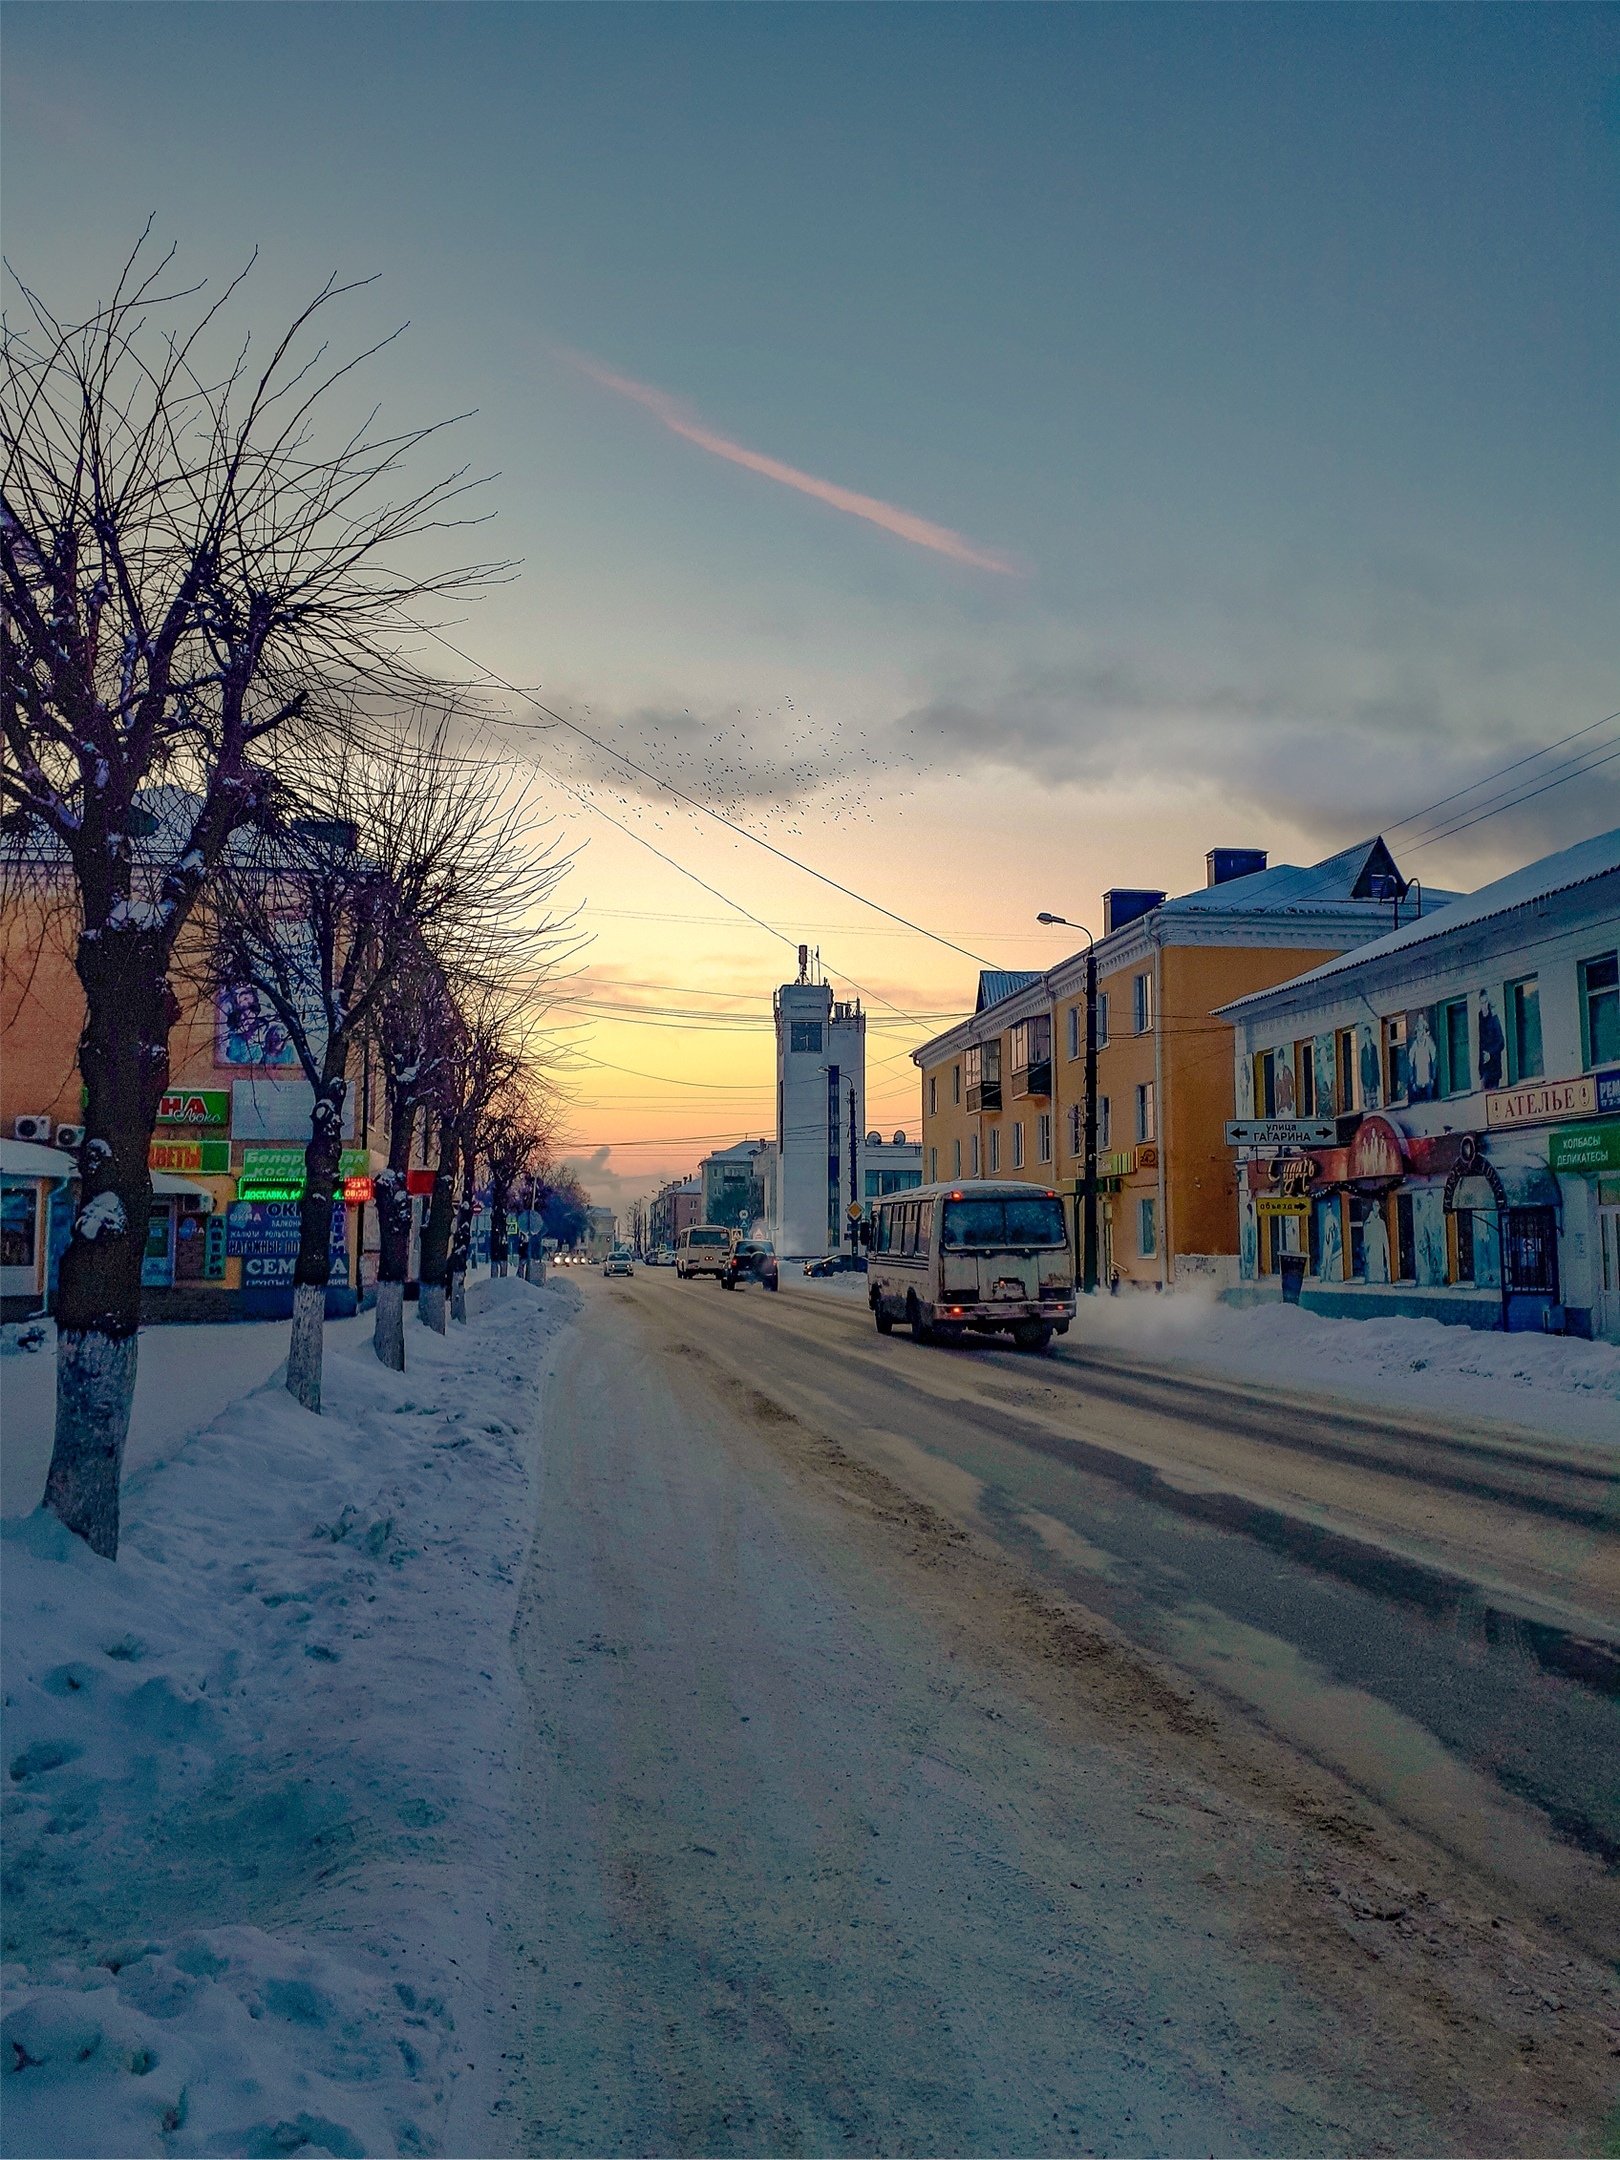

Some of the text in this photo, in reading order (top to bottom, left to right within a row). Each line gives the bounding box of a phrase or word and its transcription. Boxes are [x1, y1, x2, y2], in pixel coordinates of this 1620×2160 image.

[1505, 1088, 1575, 1117] АТЕЛЬЕ
[1266, 1123, 1297, 1134] улица
[1253, 1132, 1311, 1142] ГАГАРИНА
[1563, 1136, 1601, 1150] КОЛБАСЫ
[1557, 1151, 1608, 1166] ДЕЛИКАТЕСЫ
[243, 1190, 290, 1200] ДОСТАВКА
[1259, 1202, 1293, 1211] объезд
[208, 1217, 224, 1276] ДВЕРИ
[228, 1240, 282, 1254] НАТЯЖНЫЕ
